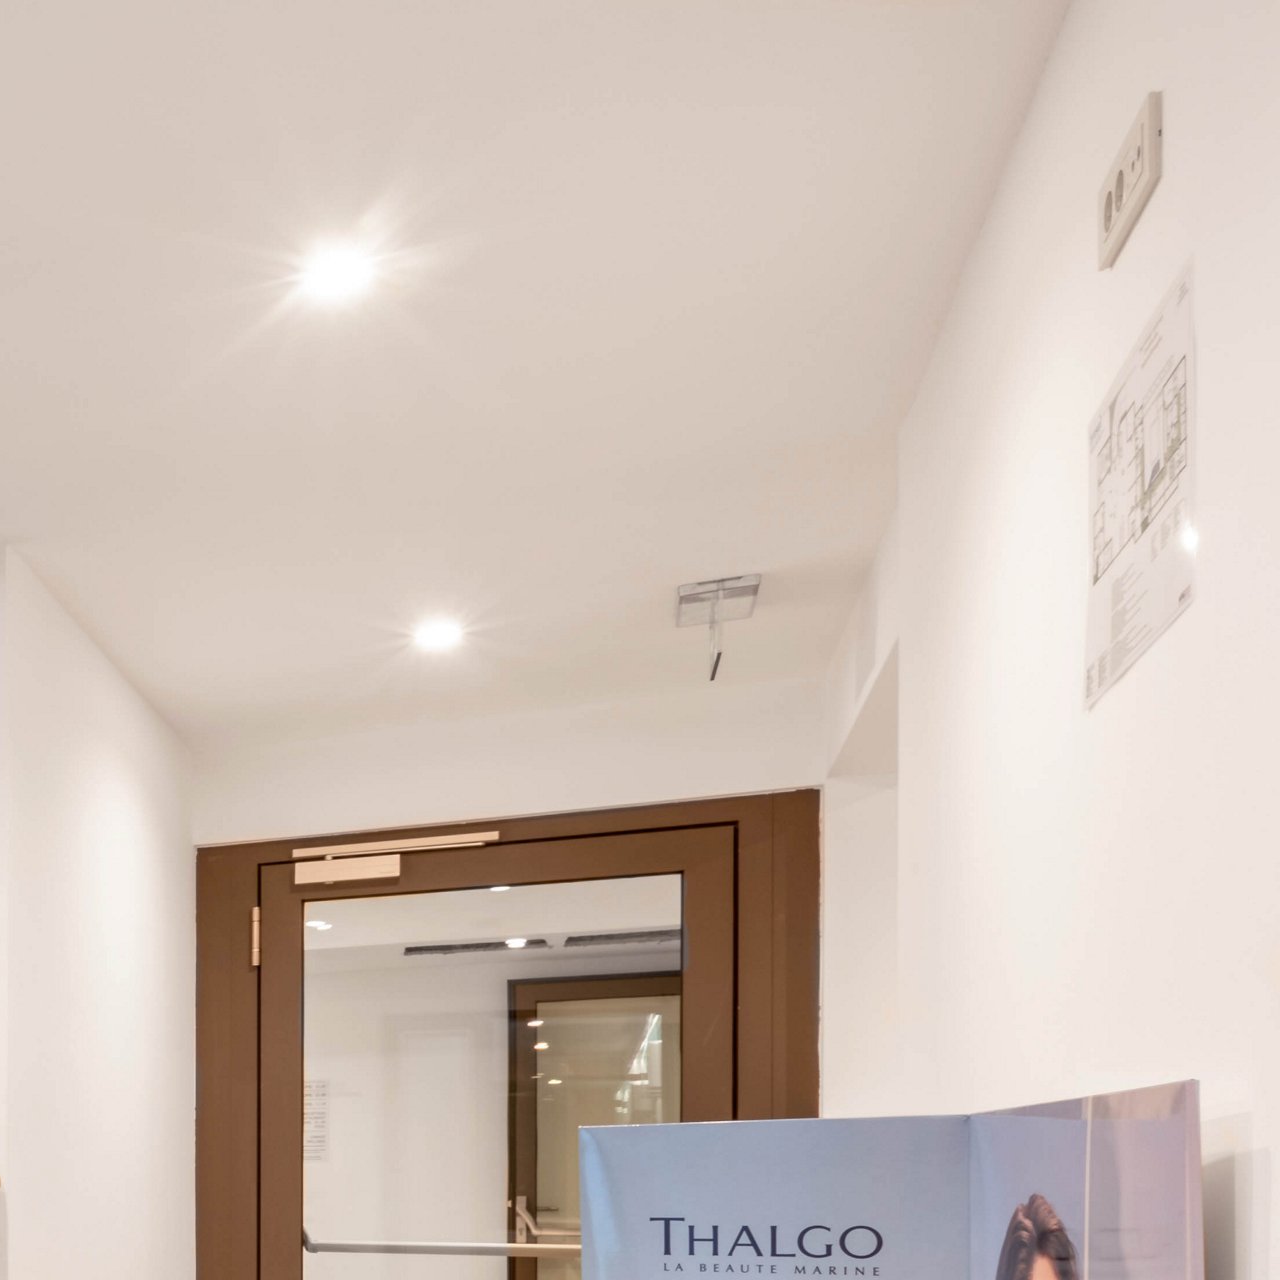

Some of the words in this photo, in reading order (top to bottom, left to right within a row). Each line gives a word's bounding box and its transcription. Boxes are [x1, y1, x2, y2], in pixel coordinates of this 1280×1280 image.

[649, 1217, 884, 1260] THALGO
[663, 1262, 684, 1273] LA
[698, 1263, 778, 1275] BEAUTE
[794, 1265, 880, 1277] MARINE
